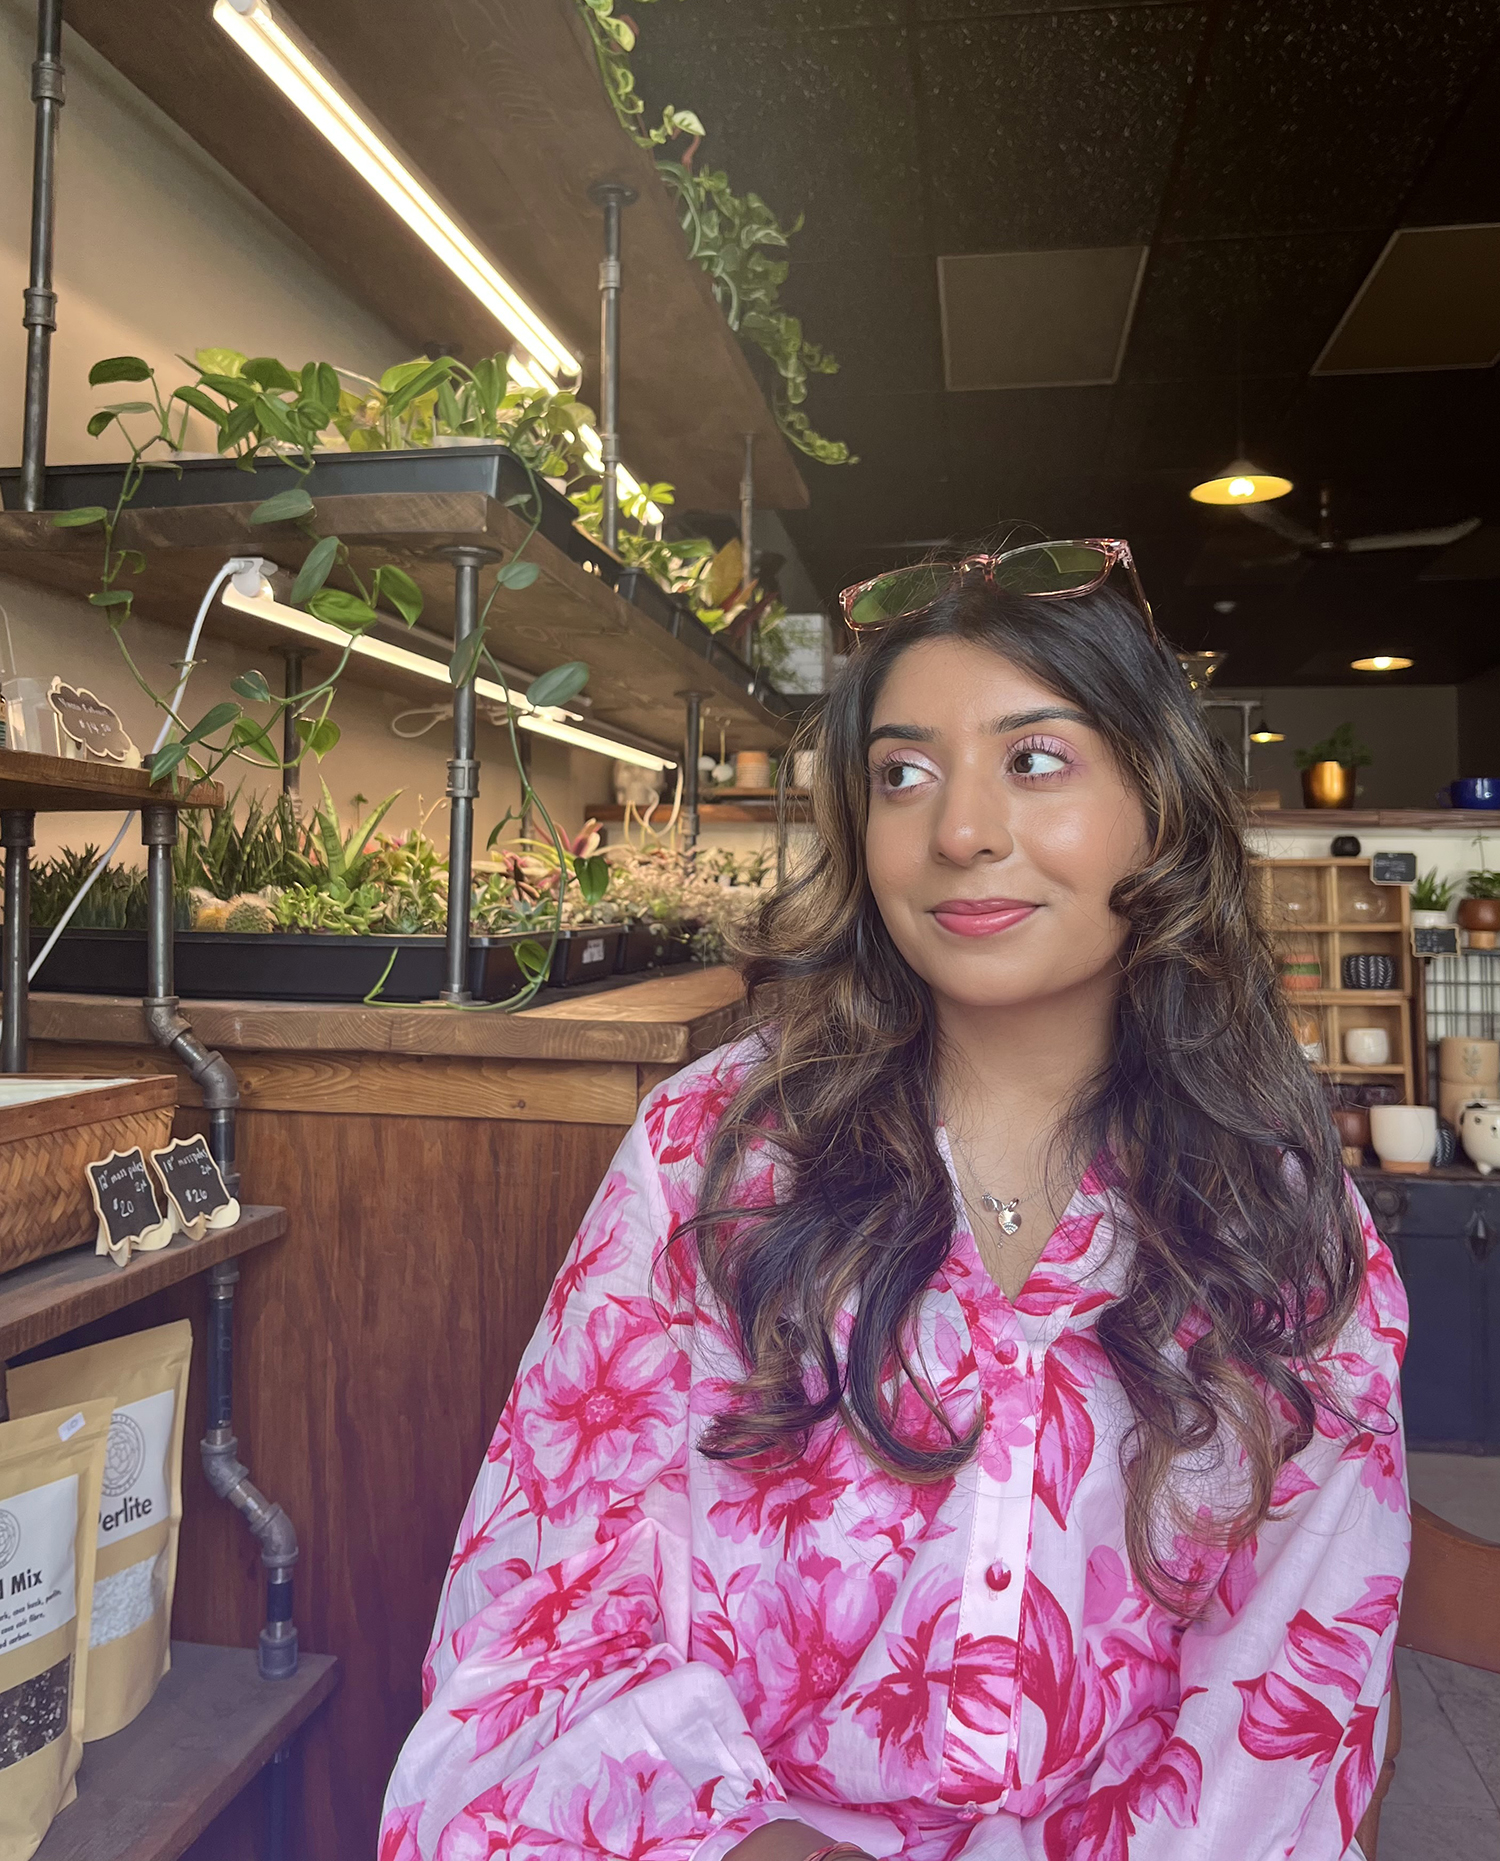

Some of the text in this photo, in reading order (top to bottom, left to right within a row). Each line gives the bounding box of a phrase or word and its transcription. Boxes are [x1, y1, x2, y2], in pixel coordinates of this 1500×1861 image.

[111, 1169, 127, 1183] moss
[185, 1189, 207, 1202] $26
[113, 1198, 134, 1217] $20
[11, 1569, 42, 1595] Mix
